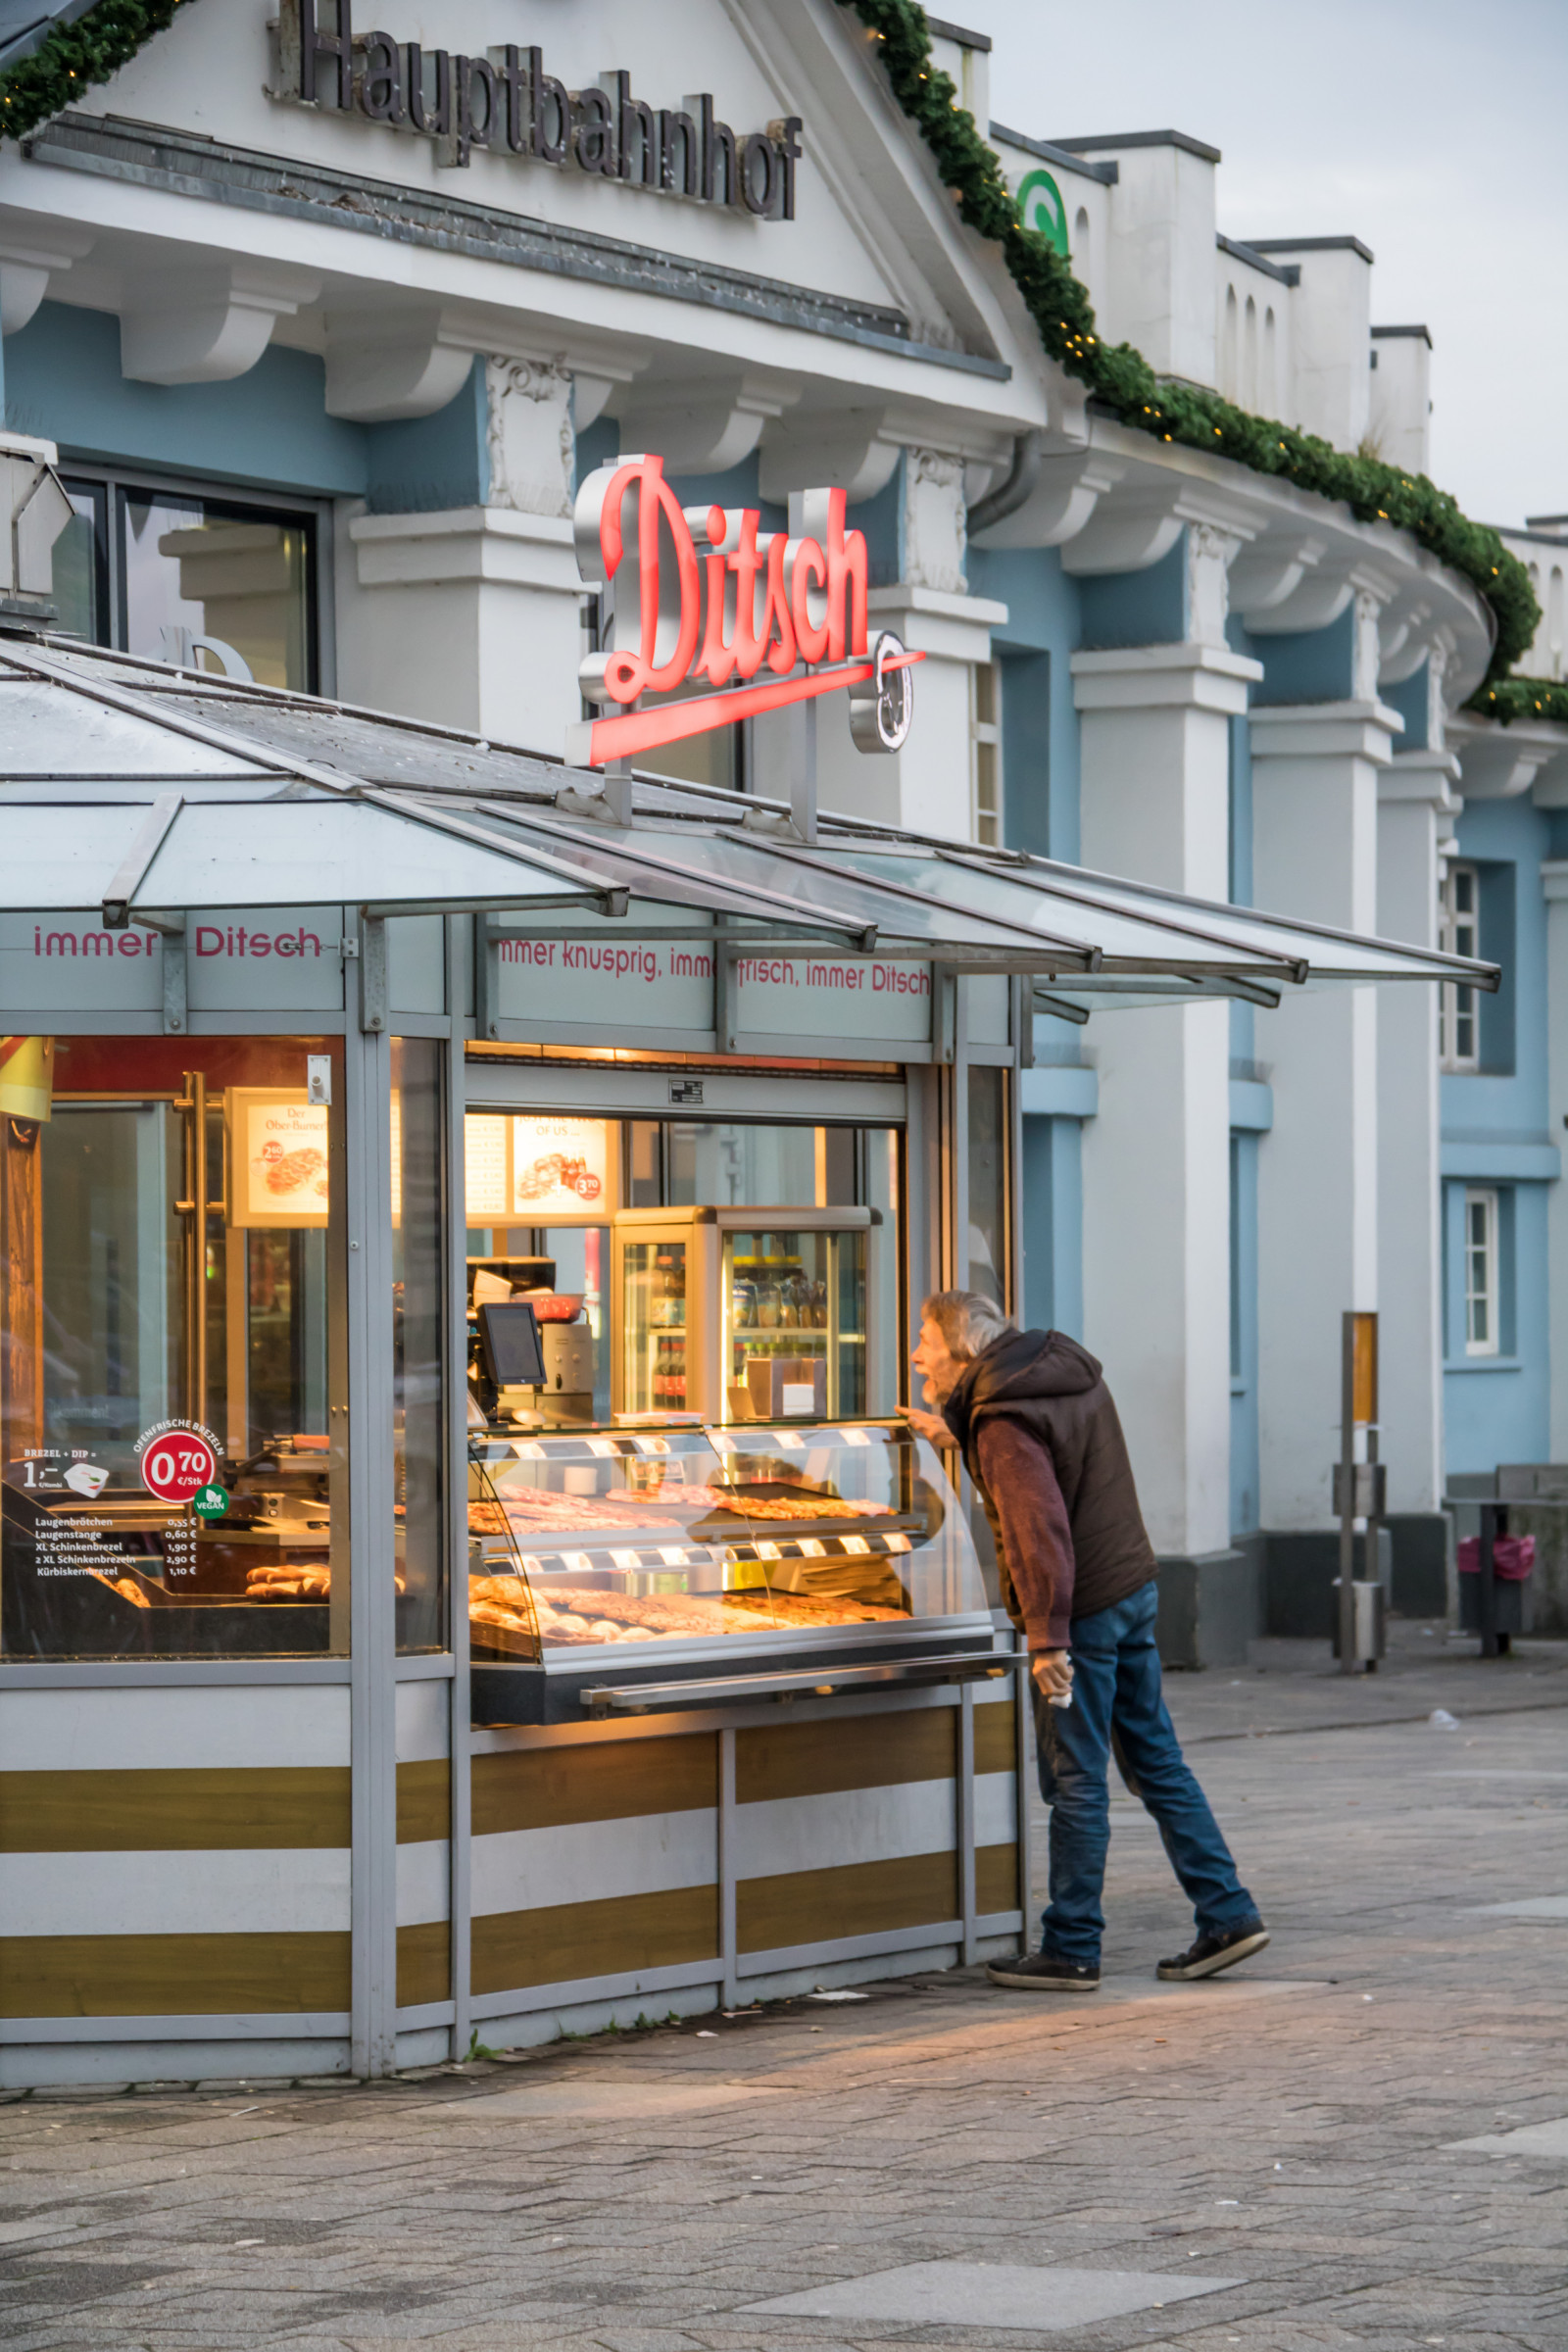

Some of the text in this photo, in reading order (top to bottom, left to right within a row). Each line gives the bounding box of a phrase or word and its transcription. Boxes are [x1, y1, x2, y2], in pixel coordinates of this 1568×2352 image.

[294, 0, 803, 220] Hauptbahnhof
[596, 453, 868, 704] Ditsch
[34, 925, 320, 957] immer Ditsch
[499, 939, 931, 996] mmer knusprig, imm frisch, immer Ditsch
[132, 1418, 225, 1456] OFENFRISCHE BREZELN
[24, 1448, 62, 1458] BREZEL
[71, 1449, 89, 1458] DIP
[176, 1476, 203, 1487] €/Stk
[35, 1517, 197, 1529] Laugenbrötchen 0,55 €
[35, 1529, 197, 1542] Laugenstange 0,60 €
[35, 1542, 197, 1553] XL Schinkenbrezel 1,90 €
[43, 1555, 55, 1564] XL
[57, 1554, 136, 1564] Schinkenbrezeln
[166, 1555, 188, 1565] 2,90
[189, 1554, 197, 1564] €
[36, 1566, 197, 1577] Kürbiskernbrezel 1,10 €
